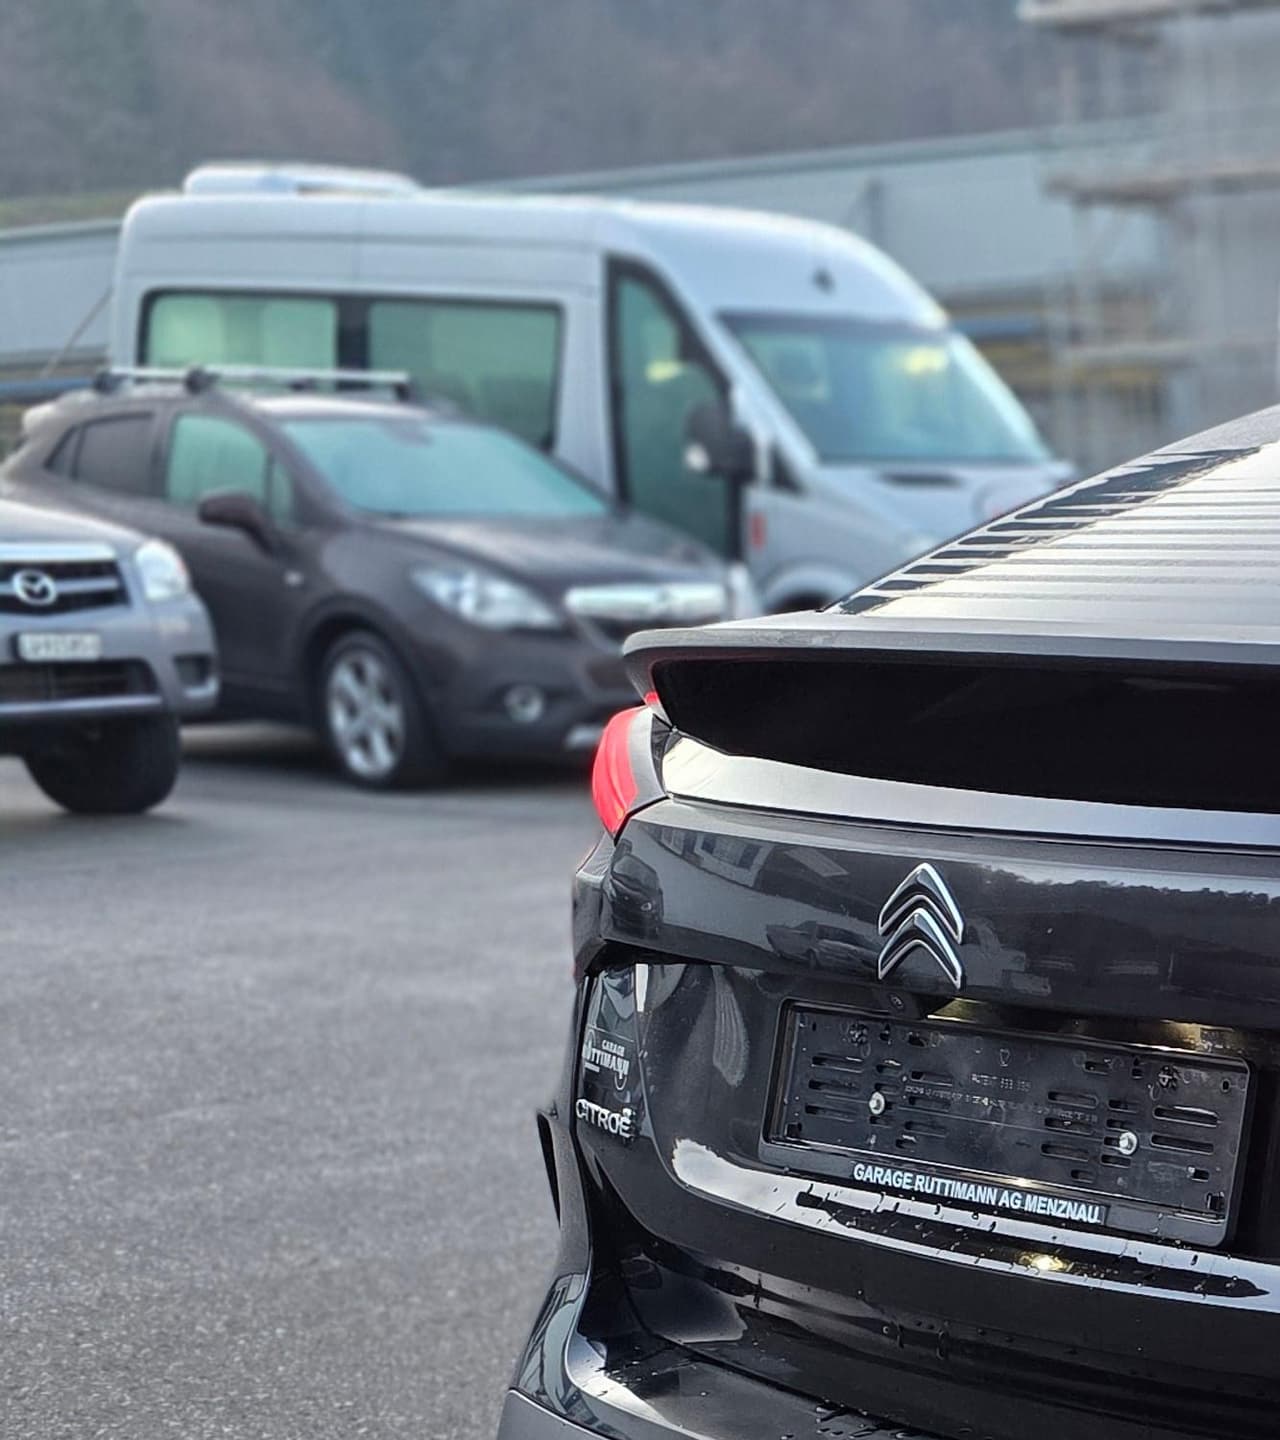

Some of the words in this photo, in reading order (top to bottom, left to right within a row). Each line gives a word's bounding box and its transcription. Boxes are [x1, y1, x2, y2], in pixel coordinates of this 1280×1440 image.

[854, 1163, 914, 1190] GARAGE
[998, 1190, 1023, 1210] AG
[1024, 1194, 1101, 1224] MENZNAU
